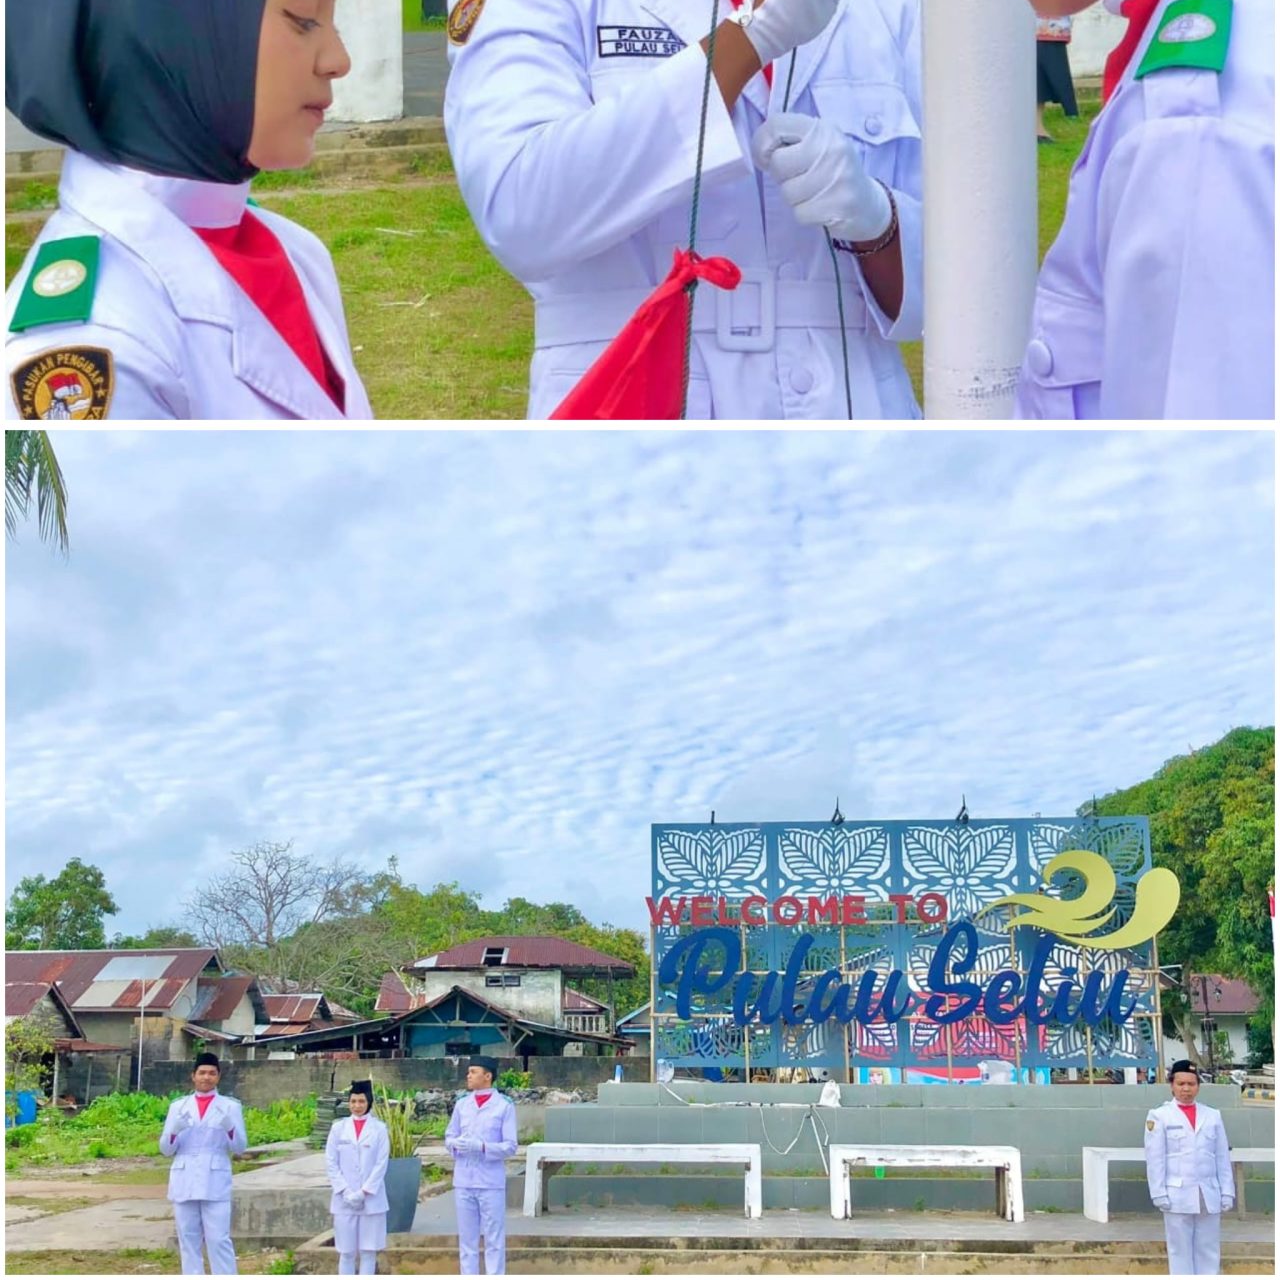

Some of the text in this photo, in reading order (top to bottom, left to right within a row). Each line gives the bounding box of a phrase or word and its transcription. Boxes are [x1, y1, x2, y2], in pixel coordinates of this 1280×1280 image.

[615, 42, 657, 53] PULAU
[23, 356, 55, 401] PASUKAN
[645, 892, 948, 927] WELCOME TO
[659, 922, 1139, 1027] Pulau Seliu
